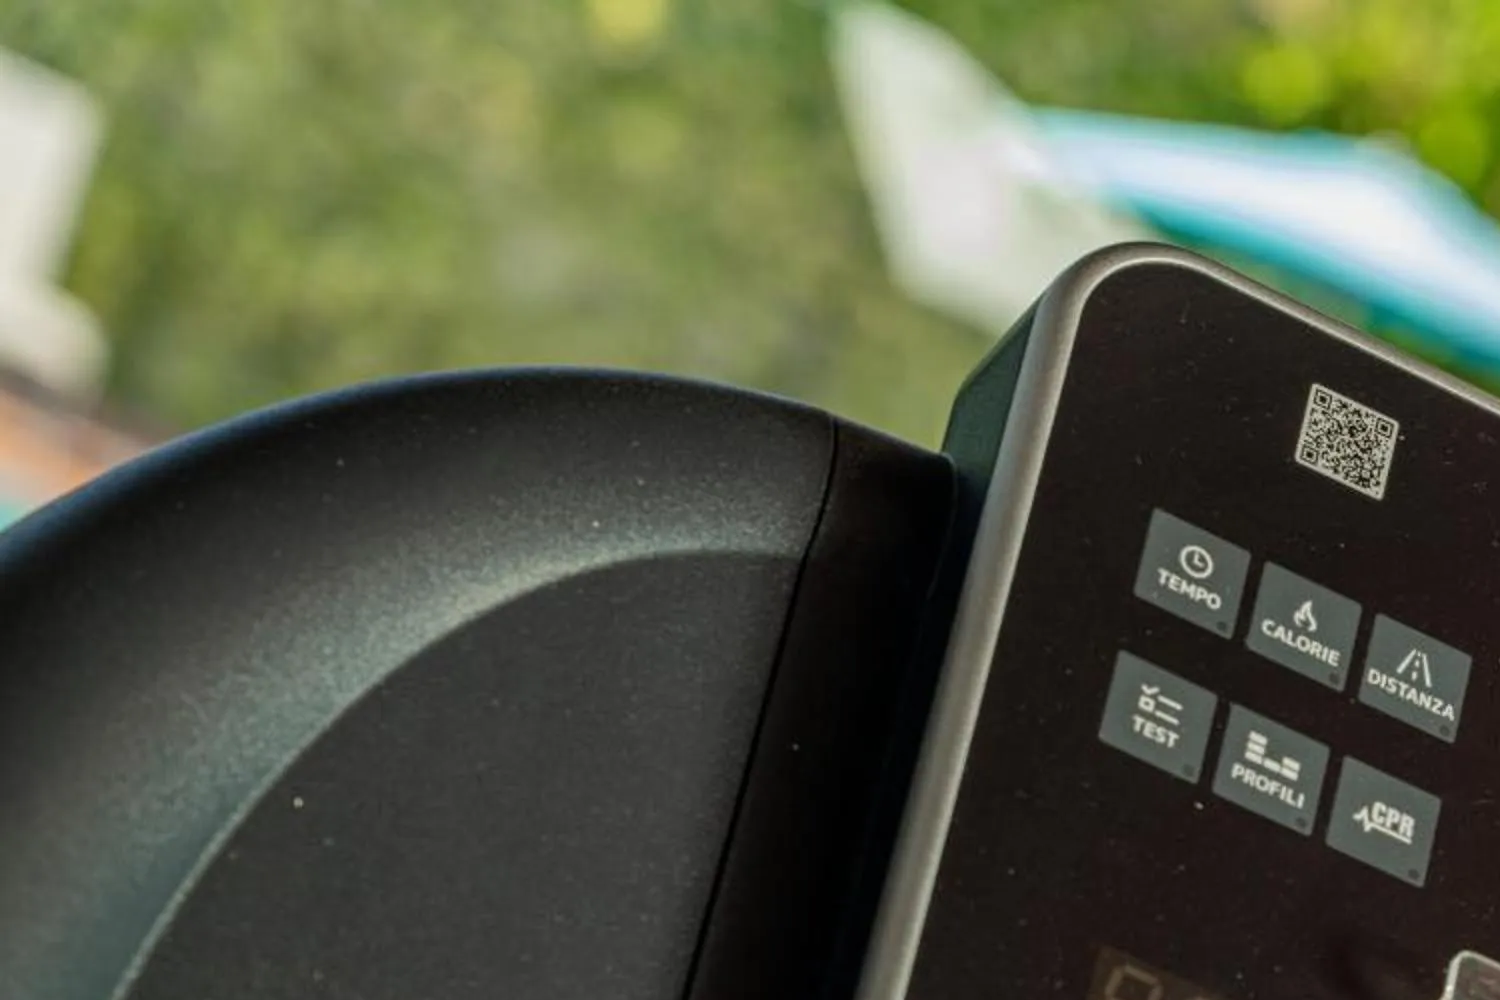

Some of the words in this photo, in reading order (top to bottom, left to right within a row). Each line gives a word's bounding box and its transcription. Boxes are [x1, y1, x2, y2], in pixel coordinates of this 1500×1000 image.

[1158, 567, 1221, 610] TEMPO
[1262, 619, 1340, 667] CALORIE
[1367, 668, 1454, 722] DISTANZA
[1132, 716, 1179, 748] TEST
[1231, 764, 1304, 809] PROFILI
[1371, 800, 1414, 837] CPR
